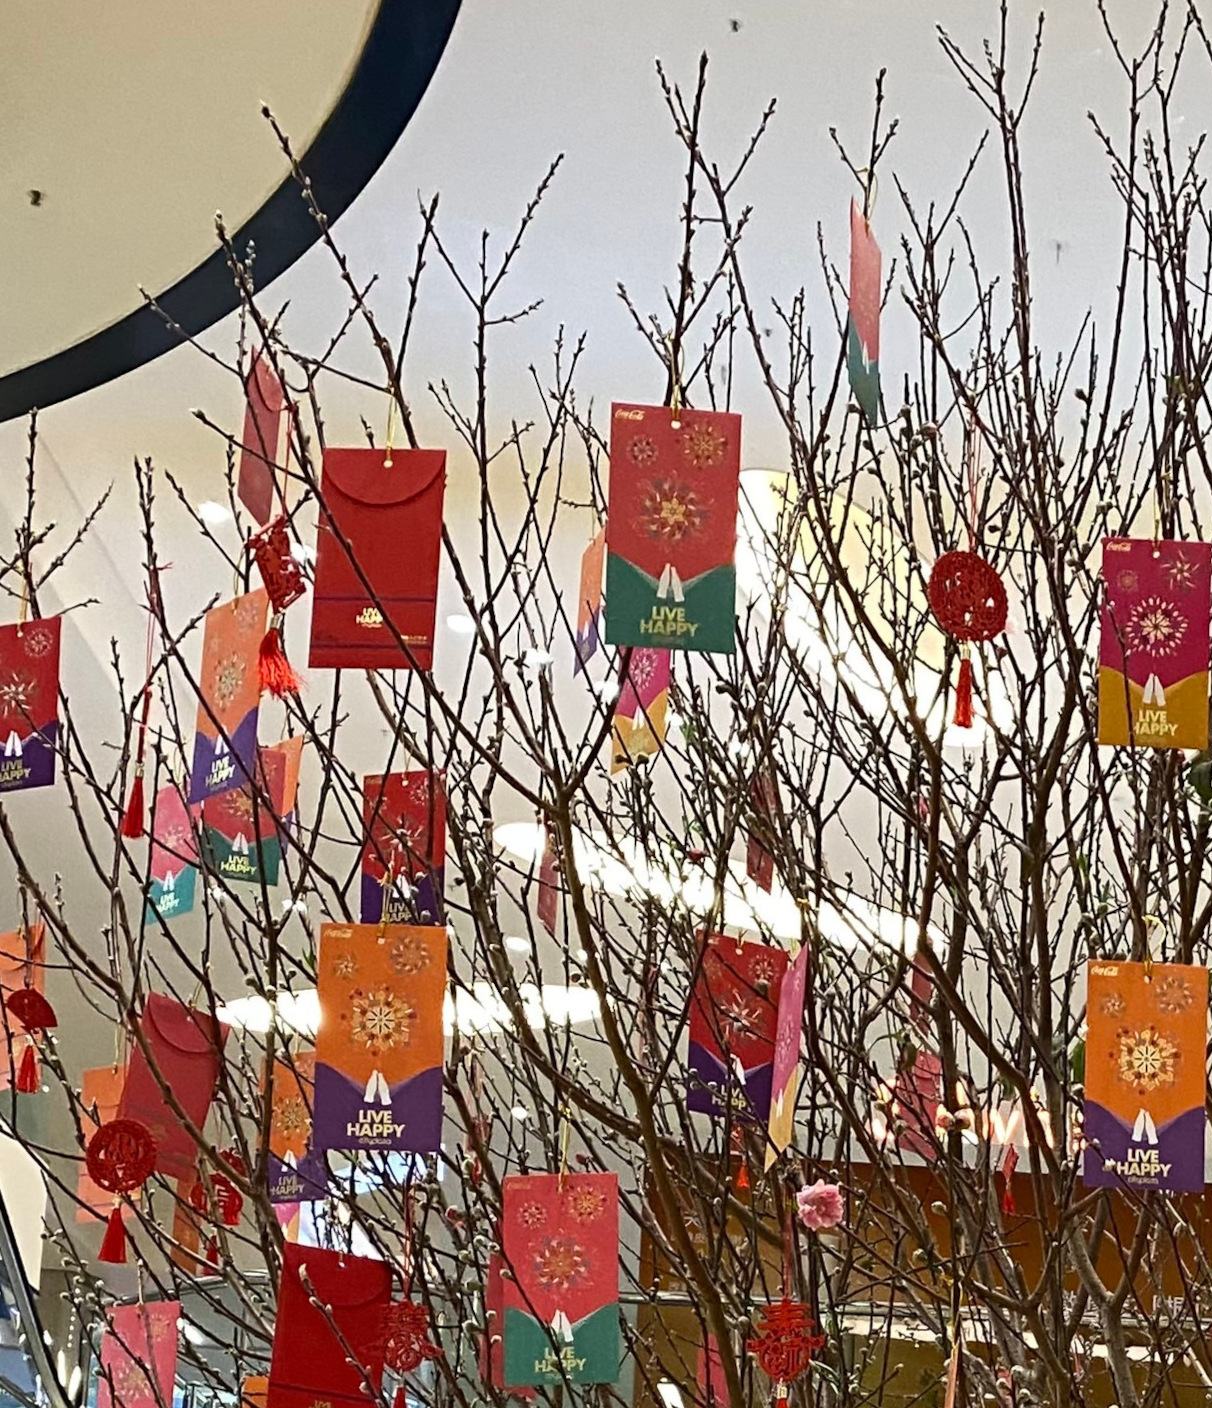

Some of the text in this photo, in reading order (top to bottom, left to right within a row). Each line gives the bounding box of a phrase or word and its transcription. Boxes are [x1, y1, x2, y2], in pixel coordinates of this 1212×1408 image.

[652, 606, 685, 622] LIVE
[640, 619, 698, 637] HAPPY
[1139, 709, 1168, 722] LIVE
[1, 760, 23, 772] LIVE
[211, 756, 230, 773] LIVE
[205, 764, 236, 787] HAPPY
[220, 860, 257, 875] HAPPY
[228, 854, 250, 866] LIVE
[359, 1109, 392, 1123] LIVE
[346, 1122, 405, 1138] HAPPY
[1127, 1148, 1159, 1163] LIVE
[1116, 1162, 1172, 1177] HAPPY
[271, 1184, 305, 1196] HAPPY
